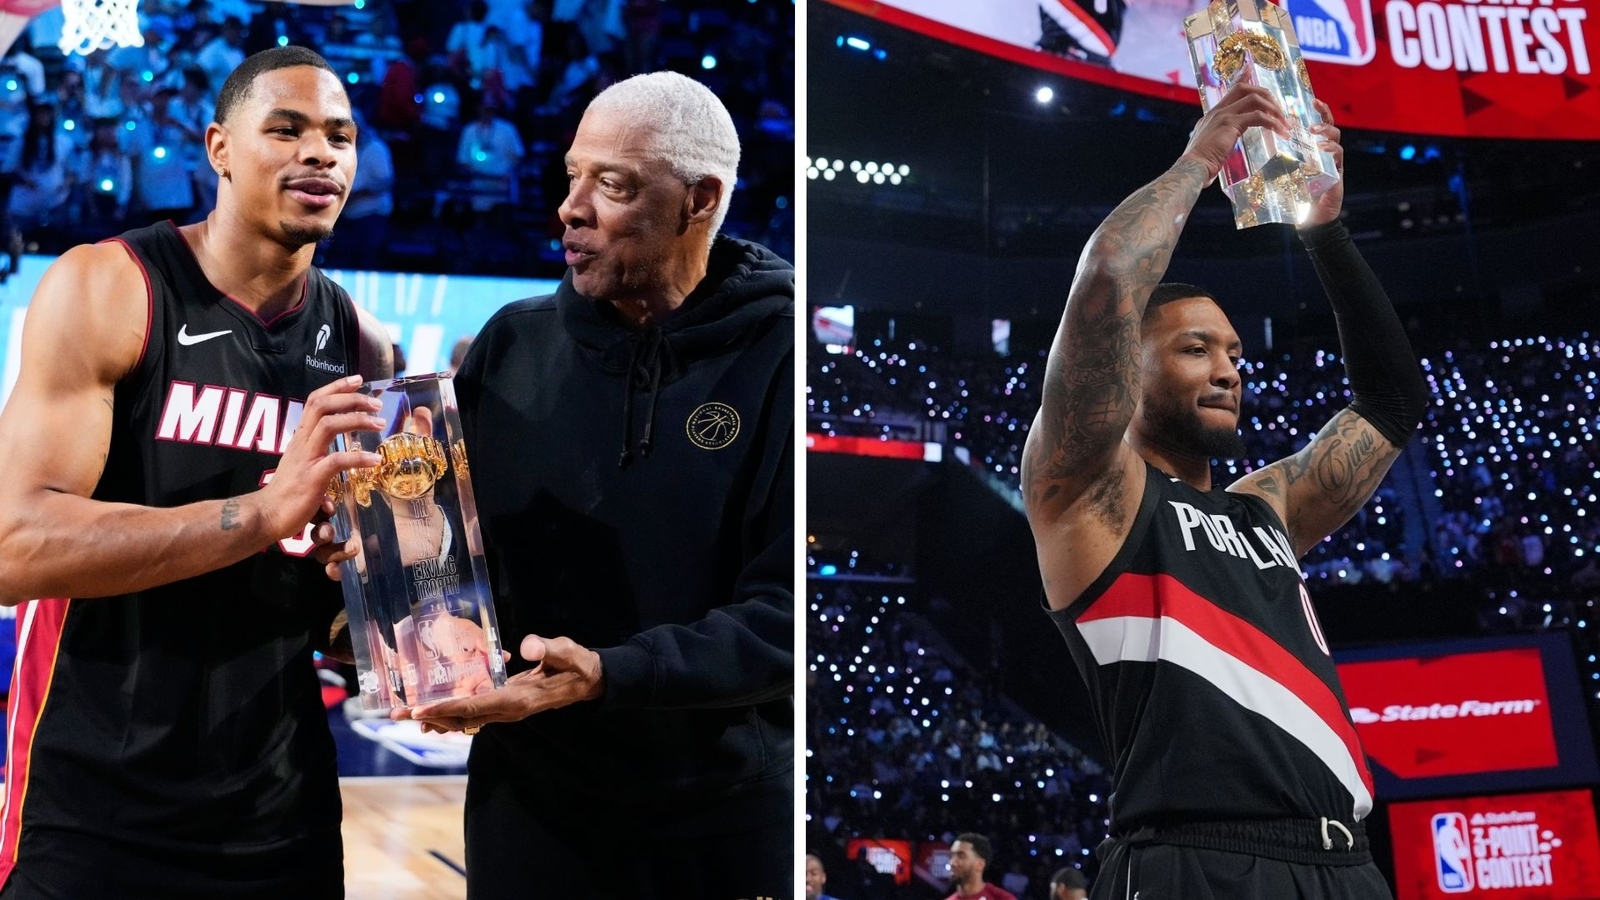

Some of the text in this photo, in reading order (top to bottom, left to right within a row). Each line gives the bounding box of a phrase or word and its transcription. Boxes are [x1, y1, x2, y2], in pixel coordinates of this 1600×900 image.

[1295, 15, 1342, 50] NBA
[1385, 0, 1591, 75] CONTEST
[305, 354, 345, 374] Robinhood
[414, 574, 460, 600] TROPHY
[1471, 823, 1539, 859] 3-POINT
[1475, 853, 1553, 890] CONTEST
